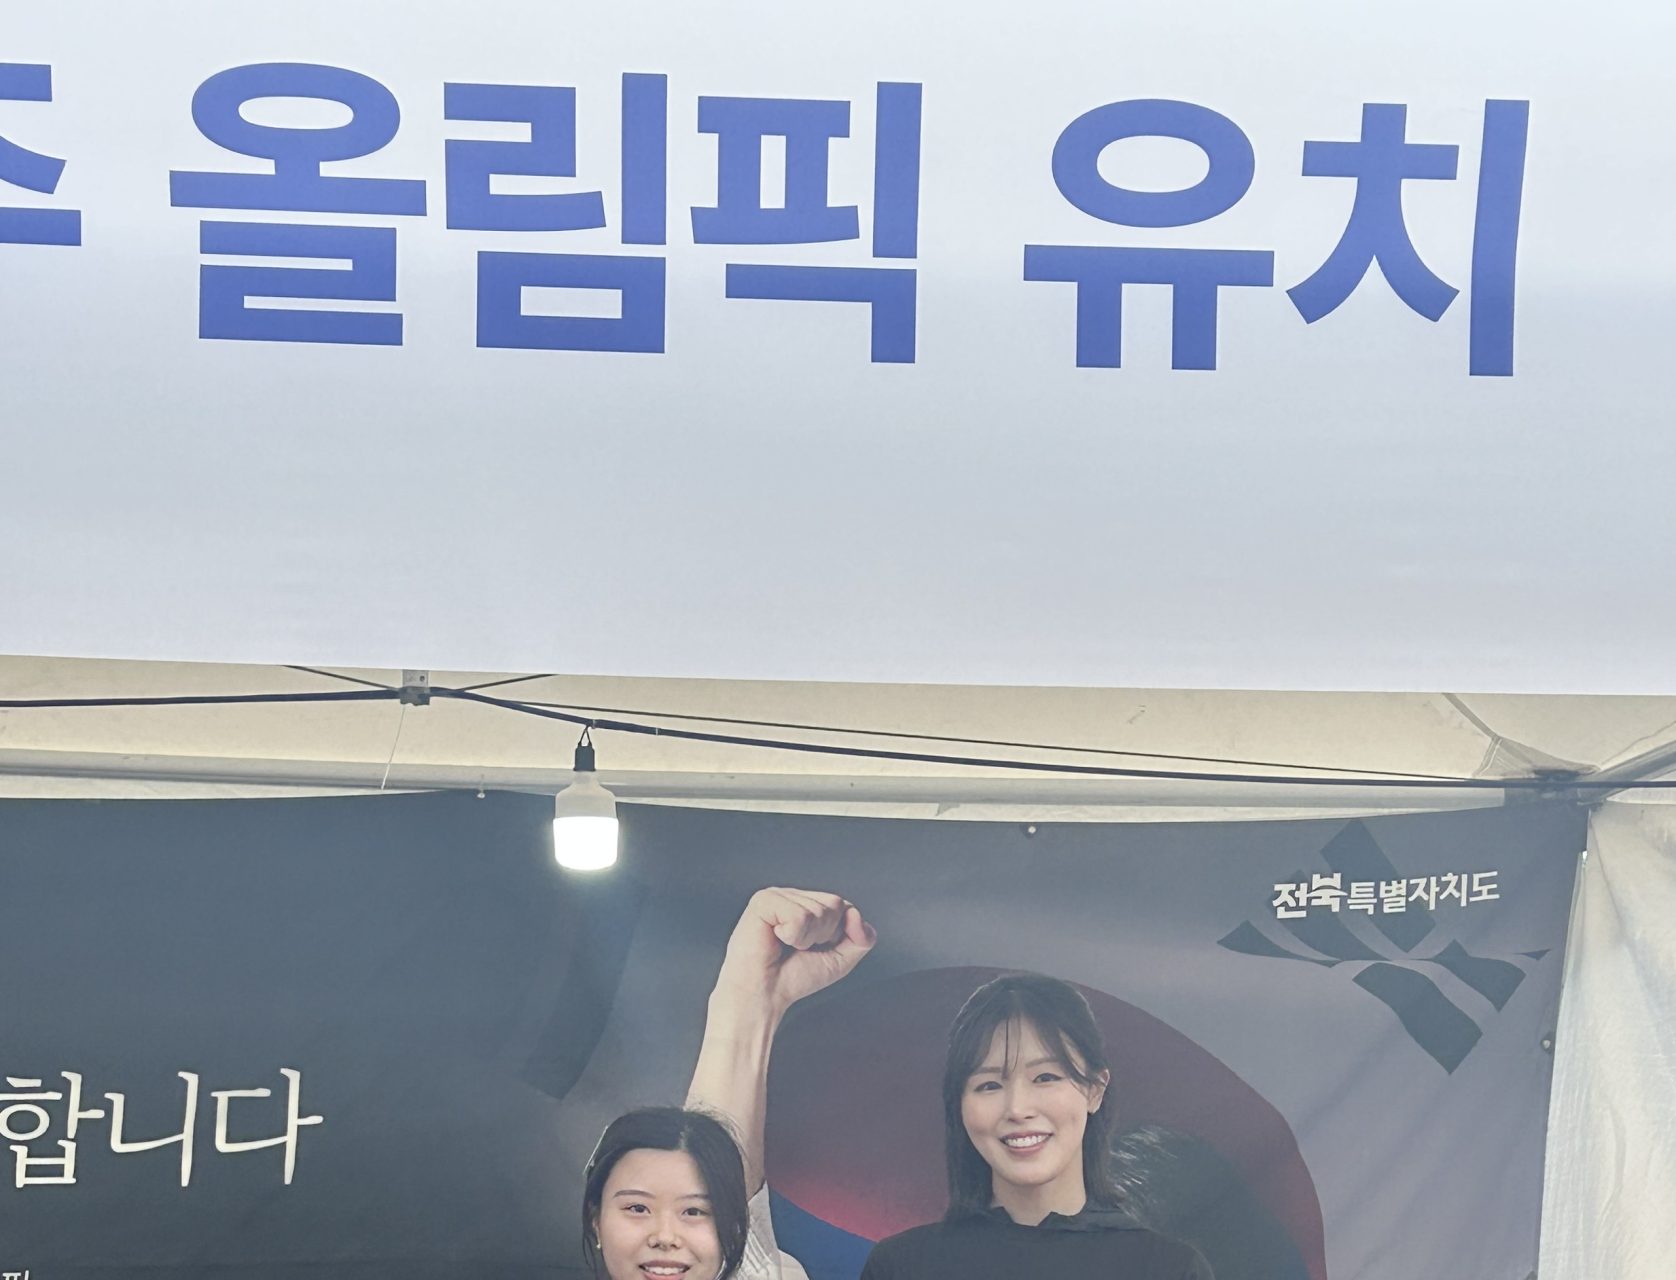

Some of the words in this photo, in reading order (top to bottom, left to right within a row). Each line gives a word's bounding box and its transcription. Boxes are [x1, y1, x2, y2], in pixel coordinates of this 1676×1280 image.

[169, 62, 922, 363] 올림픽
[1023, 99, 1530, 376] 유치
[1272, 871, 1500, 919] 전북특별자치도
